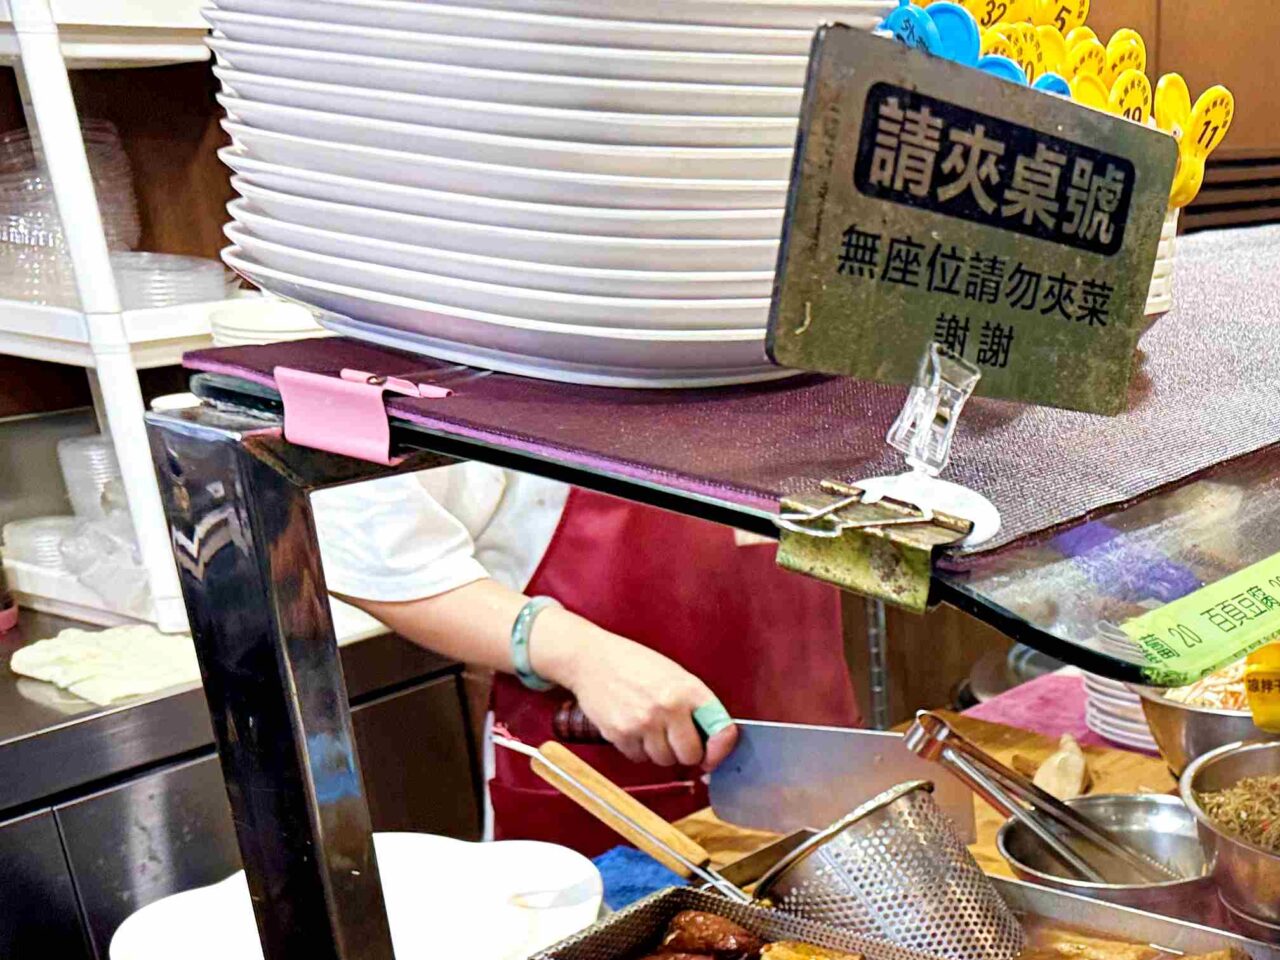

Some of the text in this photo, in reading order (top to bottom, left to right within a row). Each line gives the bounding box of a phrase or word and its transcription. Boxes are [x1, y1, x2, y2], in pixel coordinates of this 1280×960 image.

[1197, 120, 1219, 149] 11
[870, 97, 1126, 247] 請夾桌號
[837, 224, 1114, 328] 無座位請勿夾菜
[1168, 624, 1203, 648] 20
